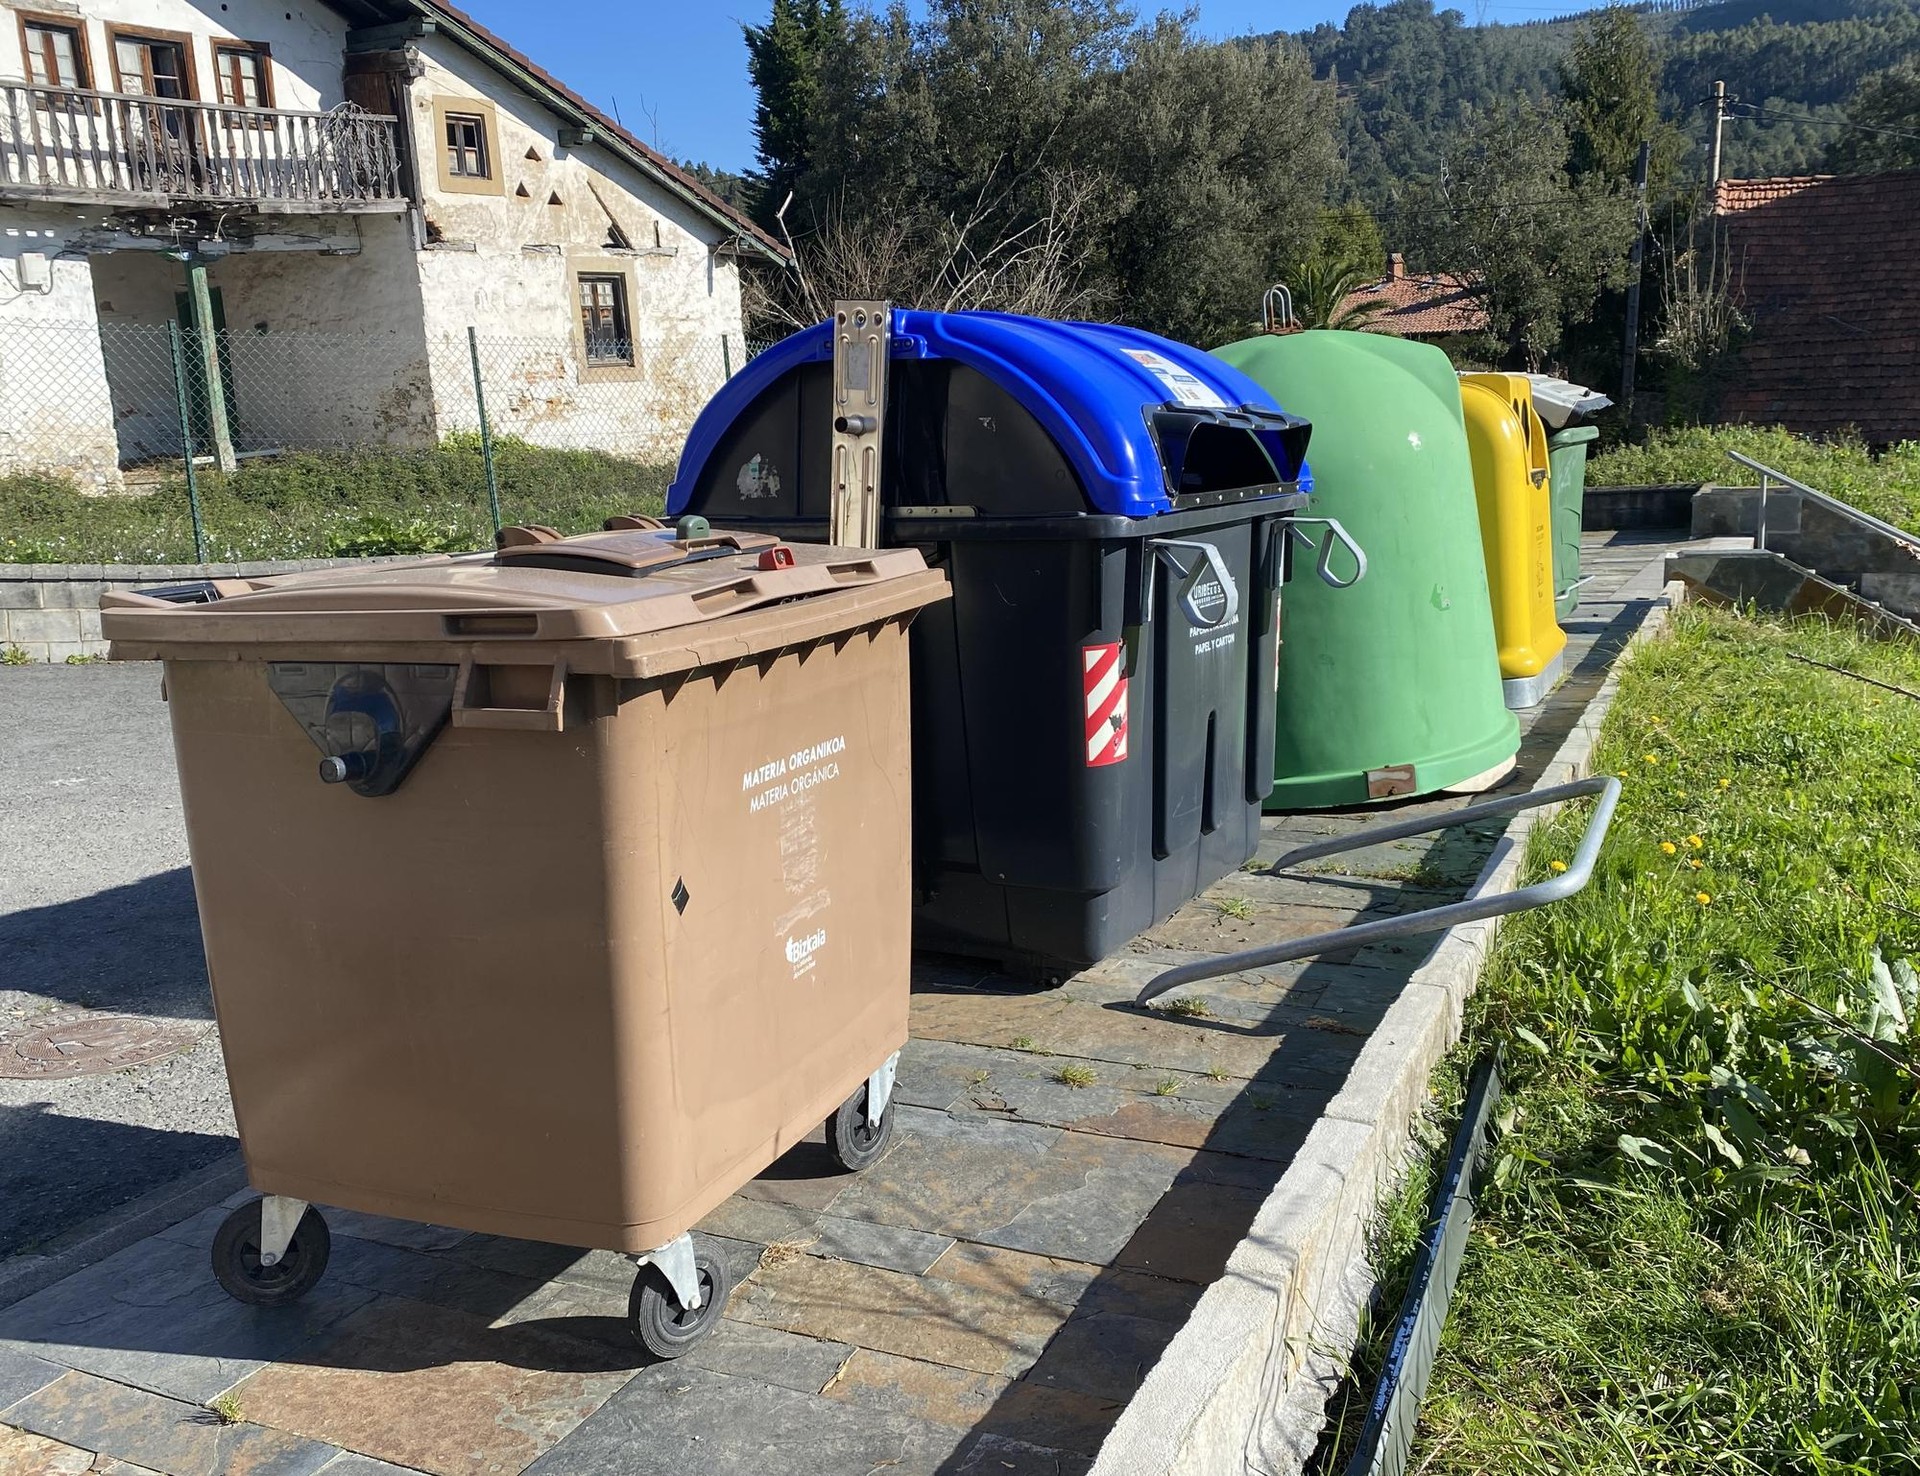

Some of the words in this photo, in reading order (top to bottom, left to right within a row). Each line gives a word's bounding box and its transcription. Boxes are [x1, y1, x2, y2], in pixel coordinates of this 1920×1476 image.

[1194, 641, 1211, 656] PAPEL
[742, 758, 786, 791] MATERIA
[789, 735, 846, 771] ORGANIKOA
[750, 783, 789, 814] MATERIA
[791, 762, 840, 794] ORGÁNICA
[792, 928, 826, 963] Bizkaia
